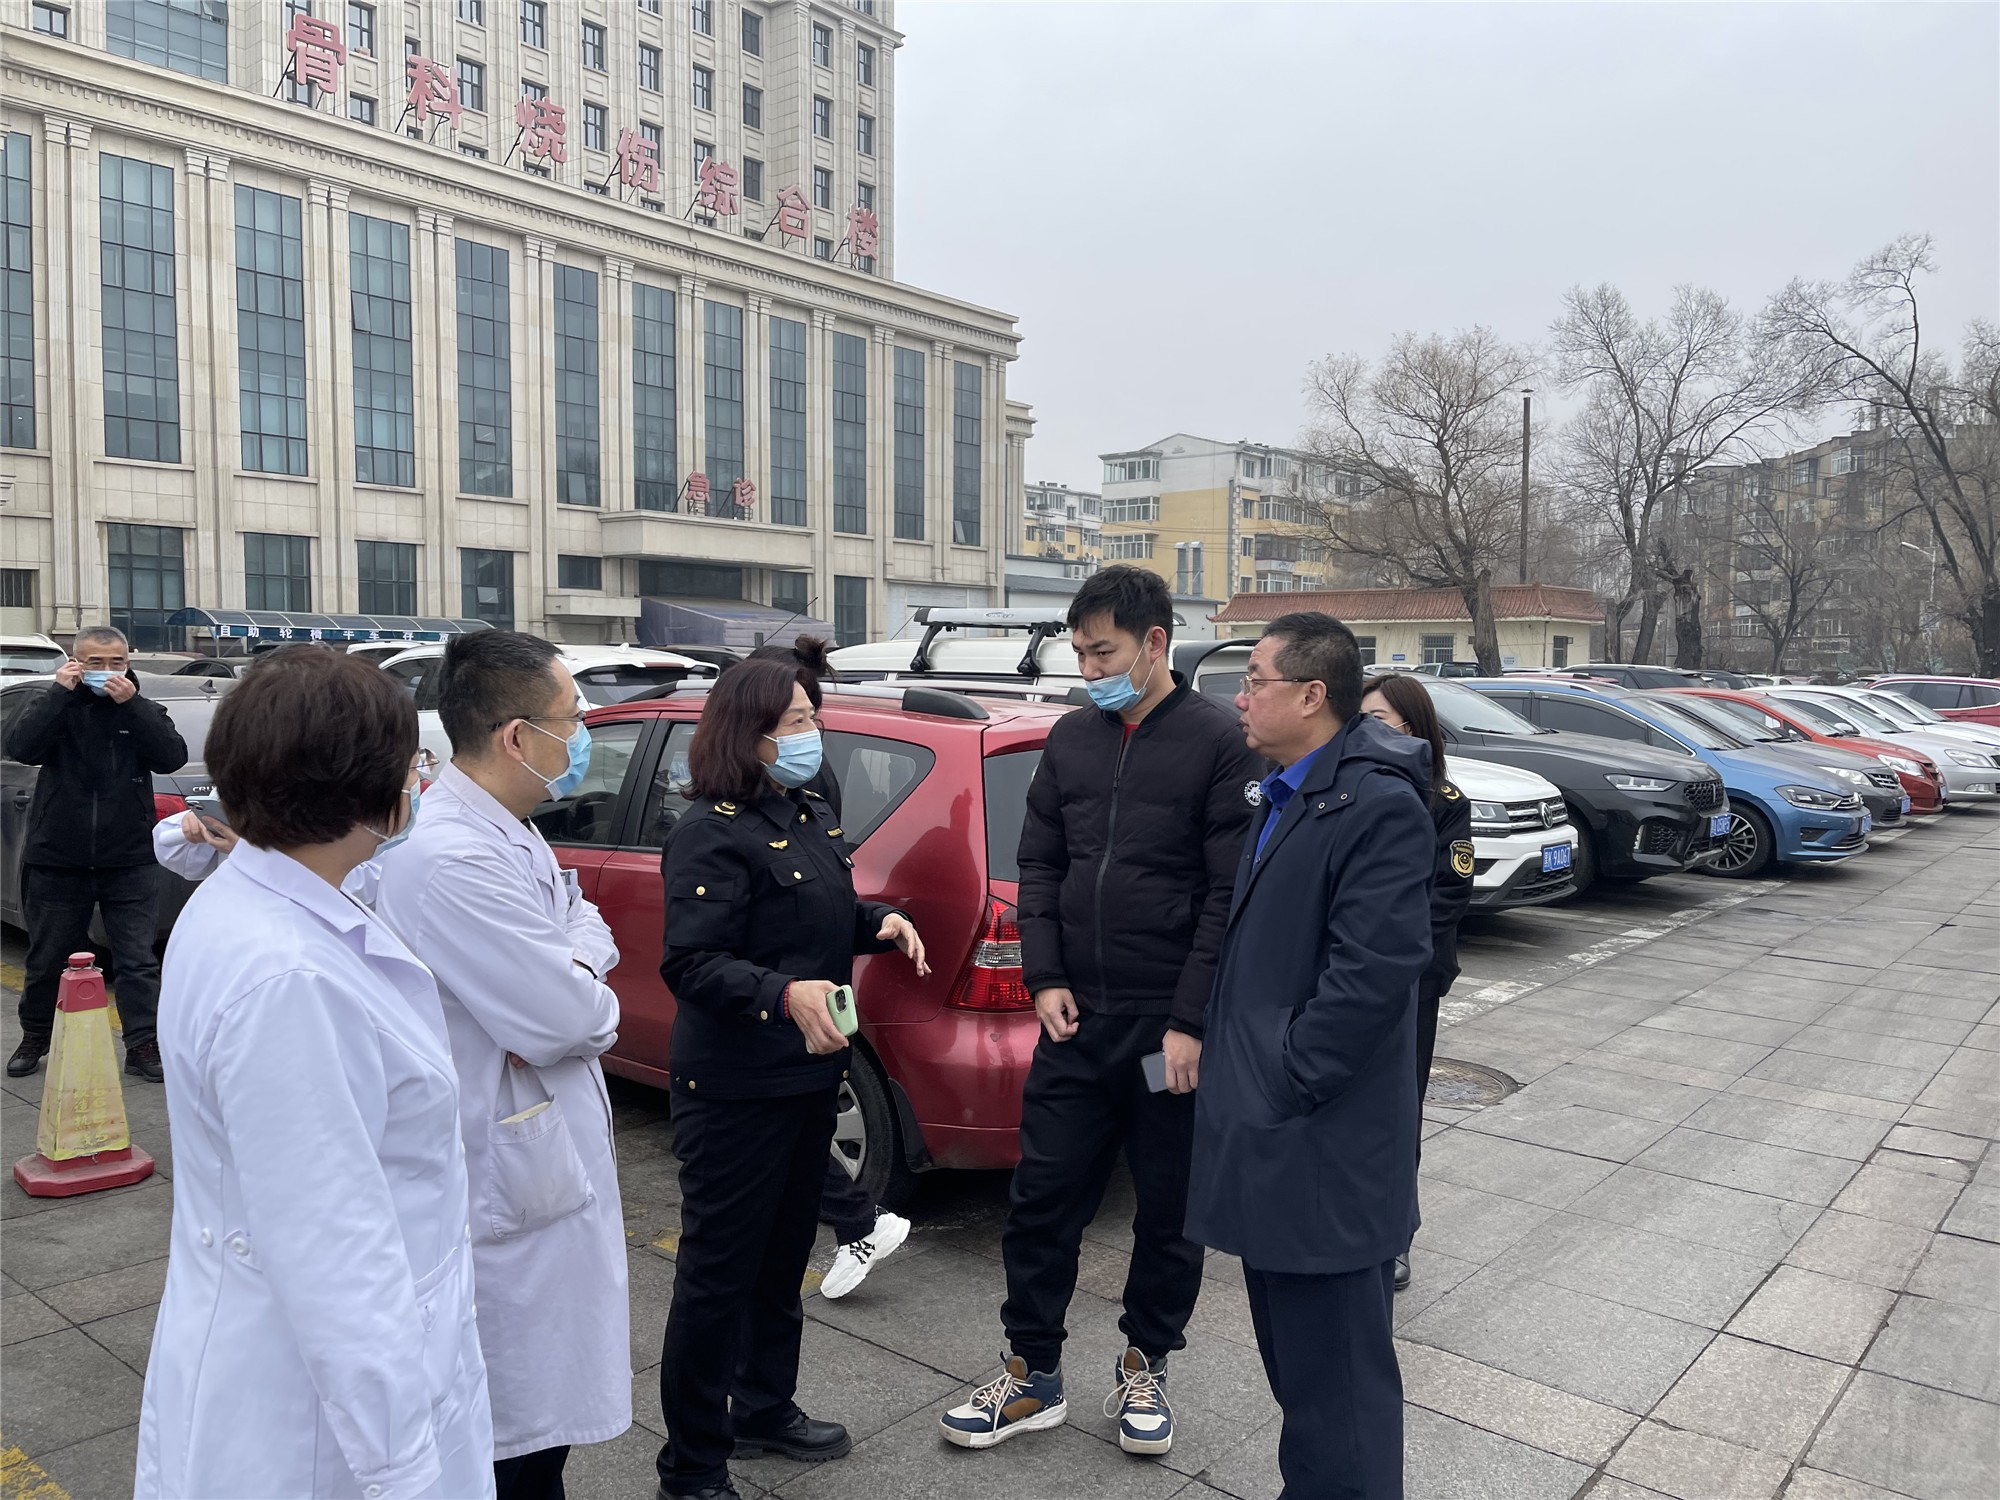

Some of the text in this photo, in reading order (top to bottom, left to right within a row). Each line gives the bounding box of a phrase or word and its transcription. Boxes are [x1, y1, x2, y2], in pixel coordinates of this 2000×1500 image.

[287, 13, 879, 260] 骨科烧伤综合楼
[685, 470, 756, 507] 急诊
[192, 785, 215, 793] CRU
